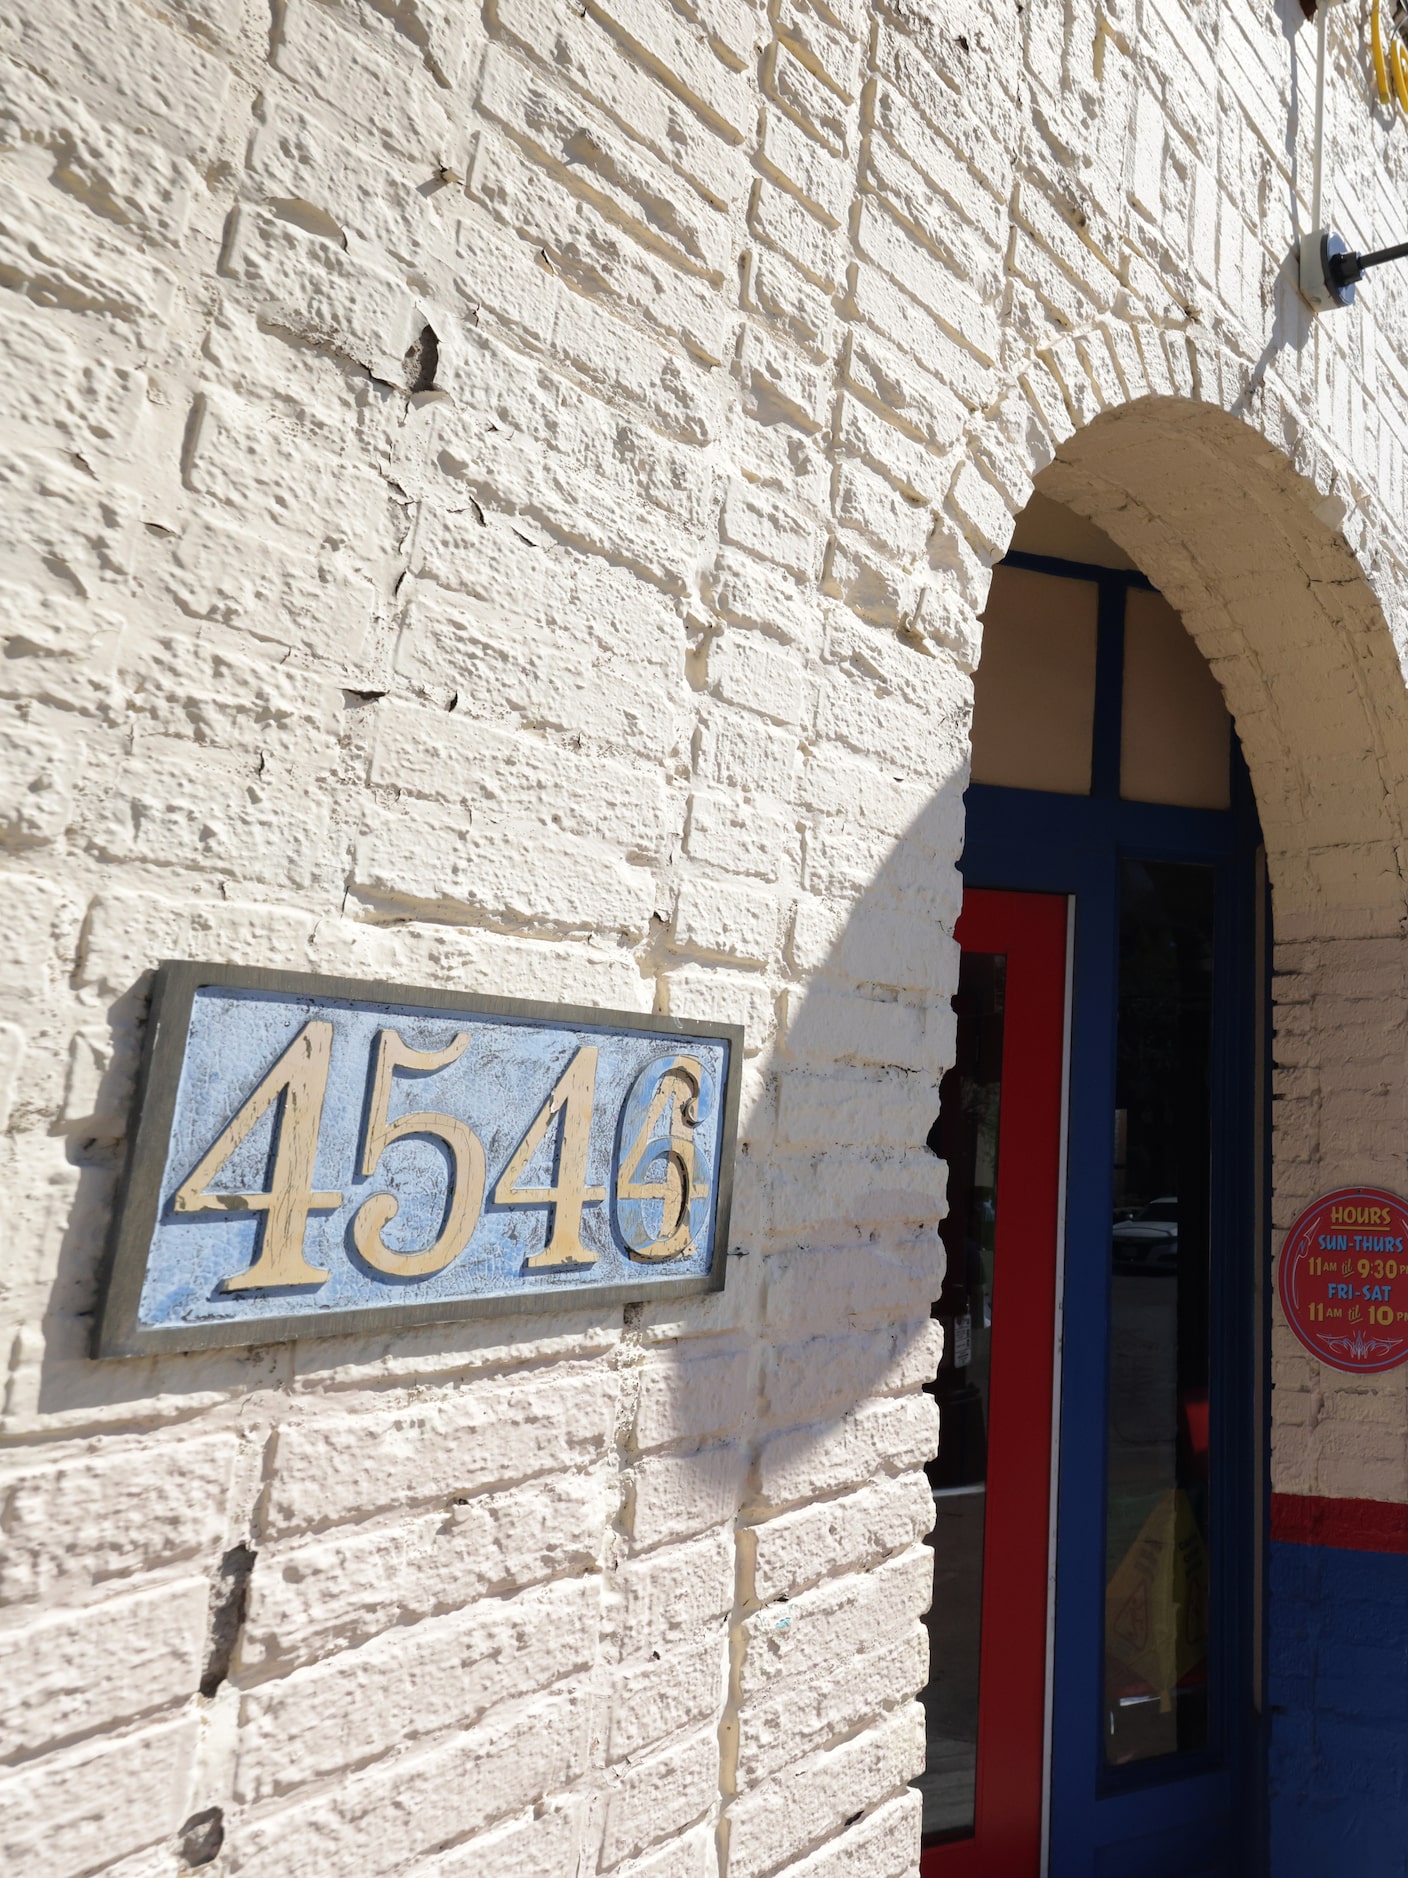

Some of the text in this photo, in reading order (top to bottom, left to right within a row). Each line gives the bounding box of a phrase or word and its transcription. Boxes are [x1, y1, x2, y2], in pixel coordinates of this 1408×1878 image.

[1331, 1206, 1392, 1225] HOURS
[1318, 1234, 1403, 1253] SUN-THURS
[1341, 1259, 1354, 1277] til
[1328, 1283, 1392, 1302] FRI-SAT
[1348, 1305, 1362, 1323] til
